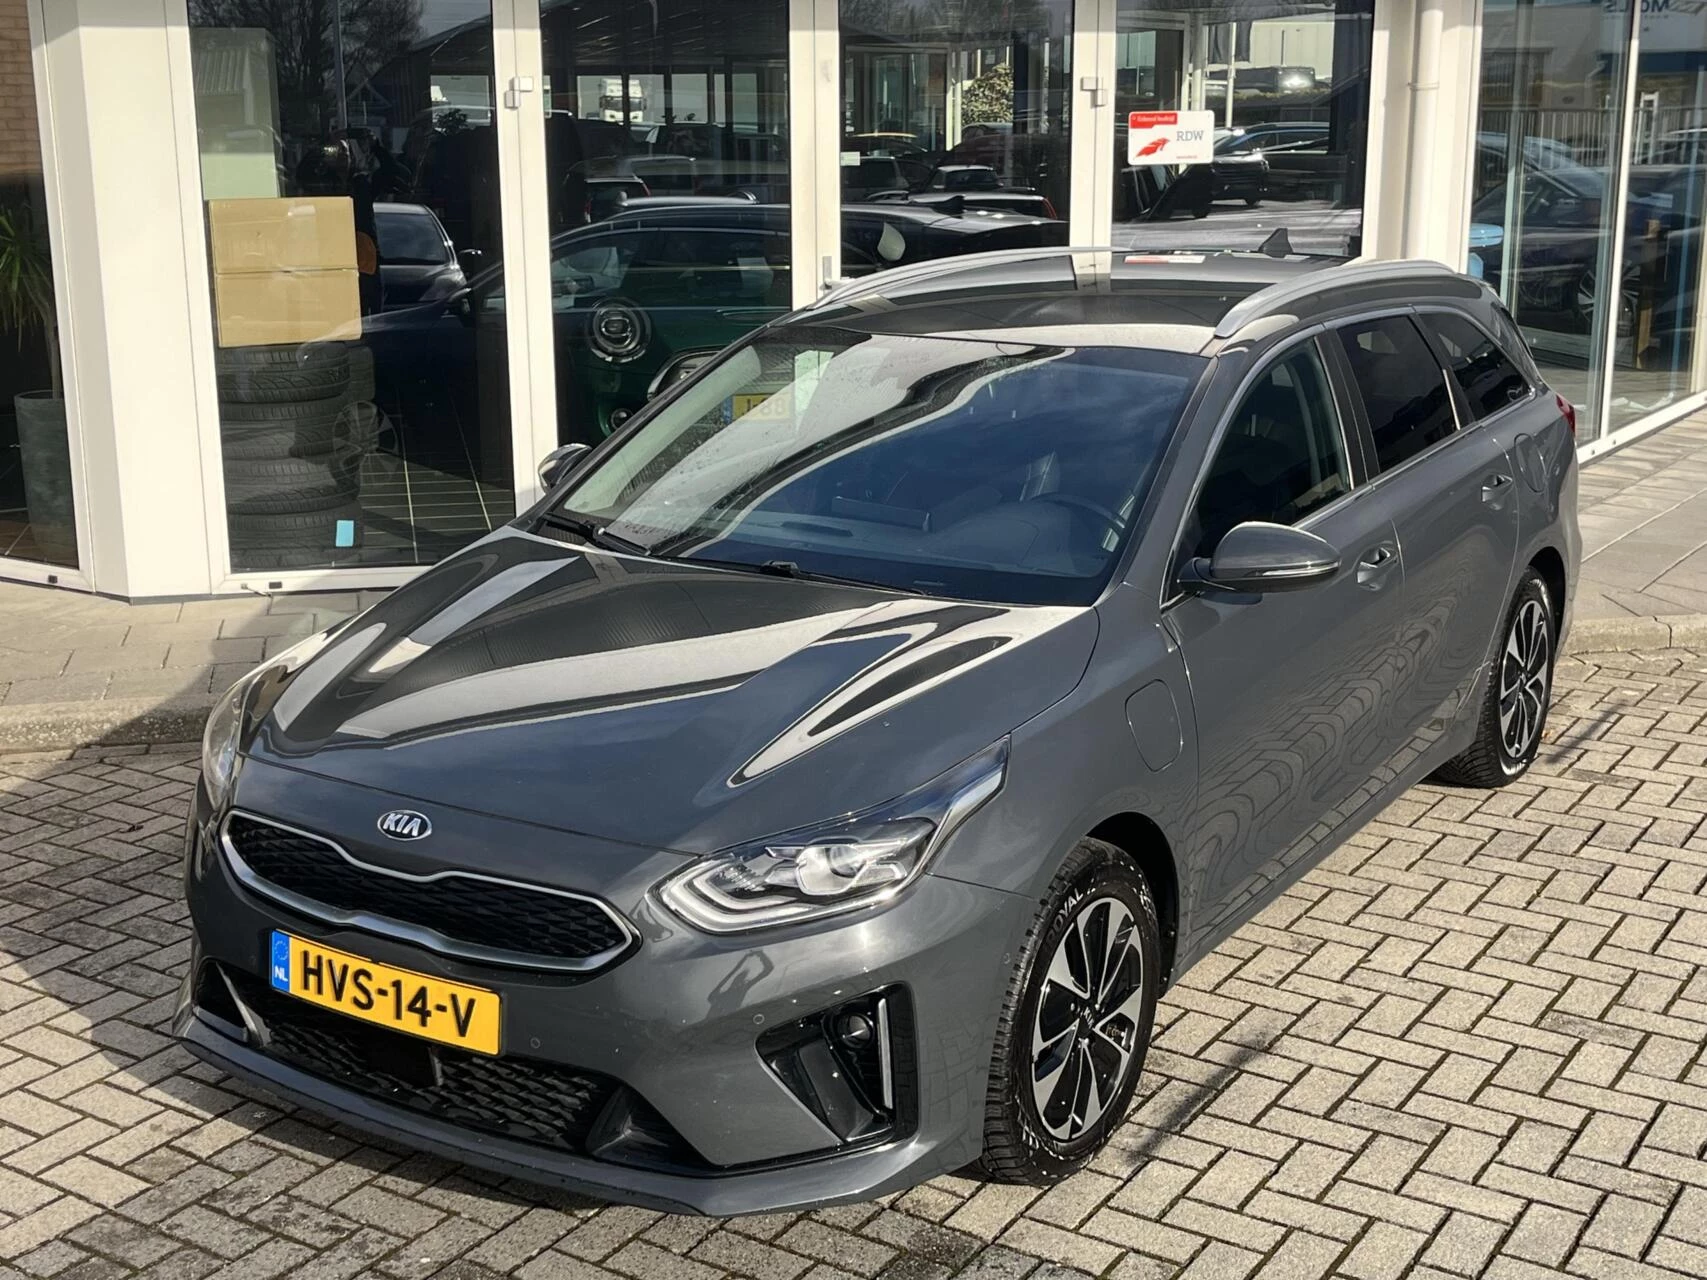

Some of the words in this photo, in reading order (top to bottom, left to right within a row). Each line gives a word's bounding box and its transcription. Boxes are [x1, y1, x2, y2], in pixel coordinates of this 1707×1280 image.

[1176, 130, 1204, 142] RDW
[383, 813, 422, 837] KIA
[274, 965, 289, 982] NL
[302, 950, 476, 1038] HVS-14-V
